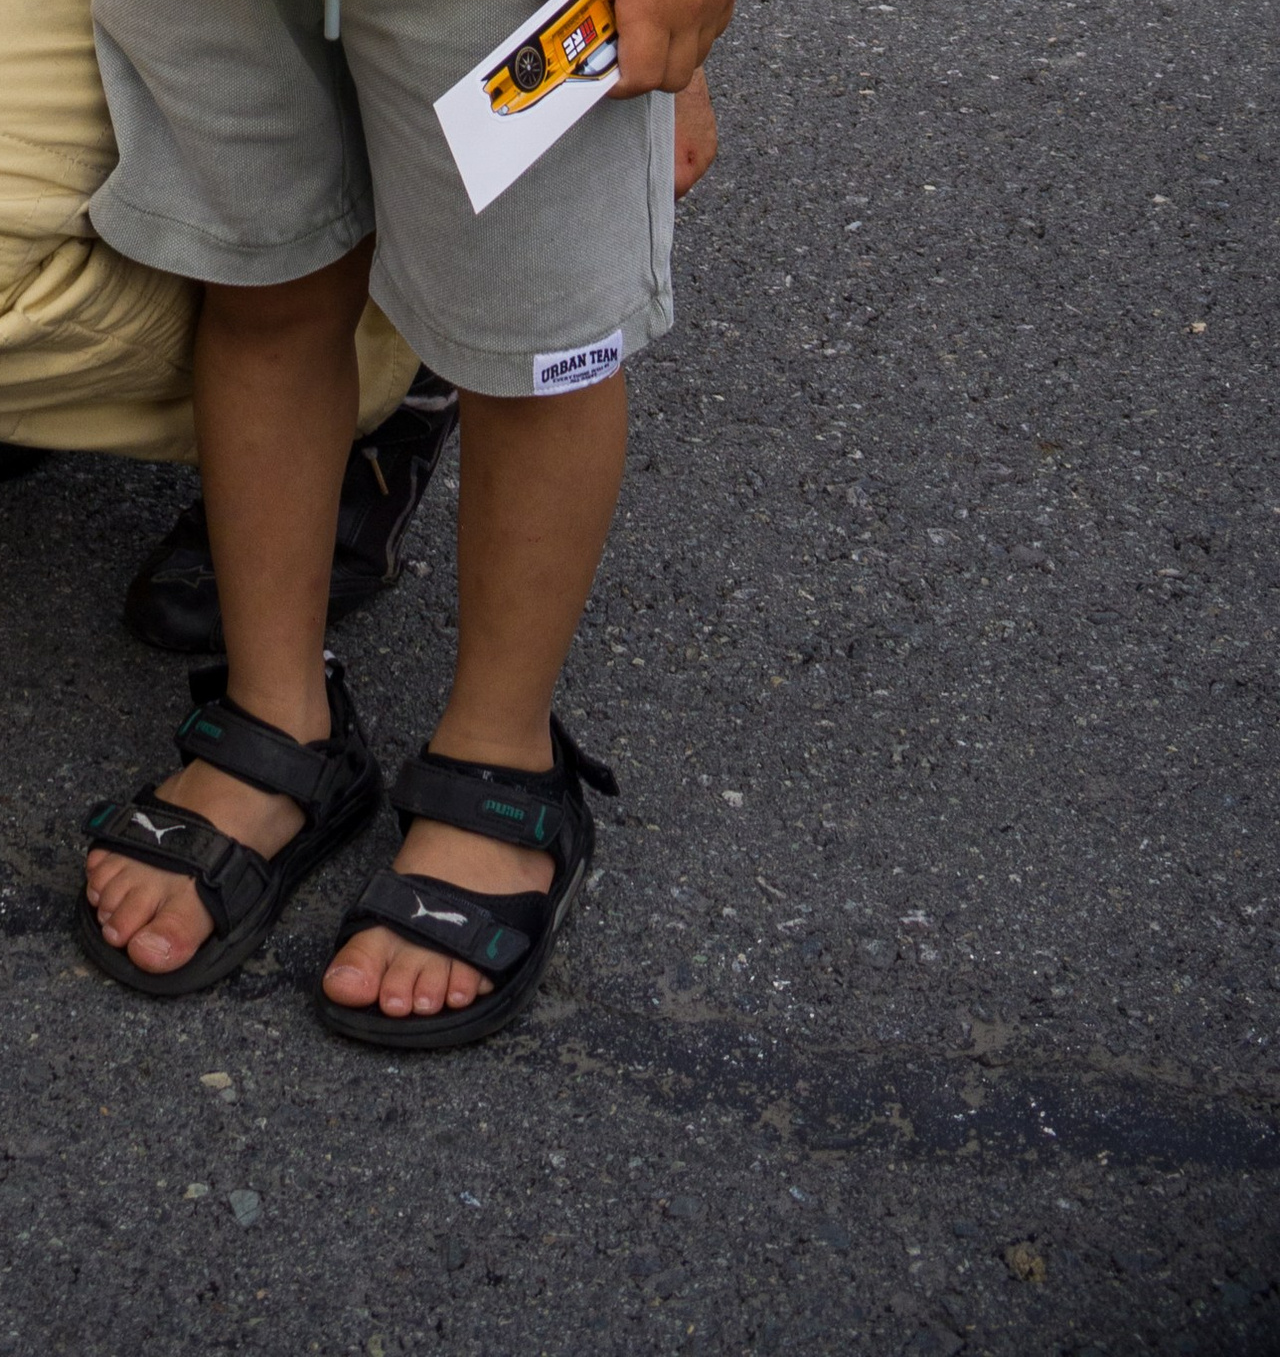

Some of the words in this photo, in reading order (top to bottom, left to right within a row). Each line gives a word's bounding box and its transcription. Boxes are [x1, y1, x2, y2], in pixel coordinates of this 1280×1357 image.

[541, 353, 587, 383] URBAN
[590, 348, 618, 365] TEAM
[484, 799, 525, 821] PUMA
